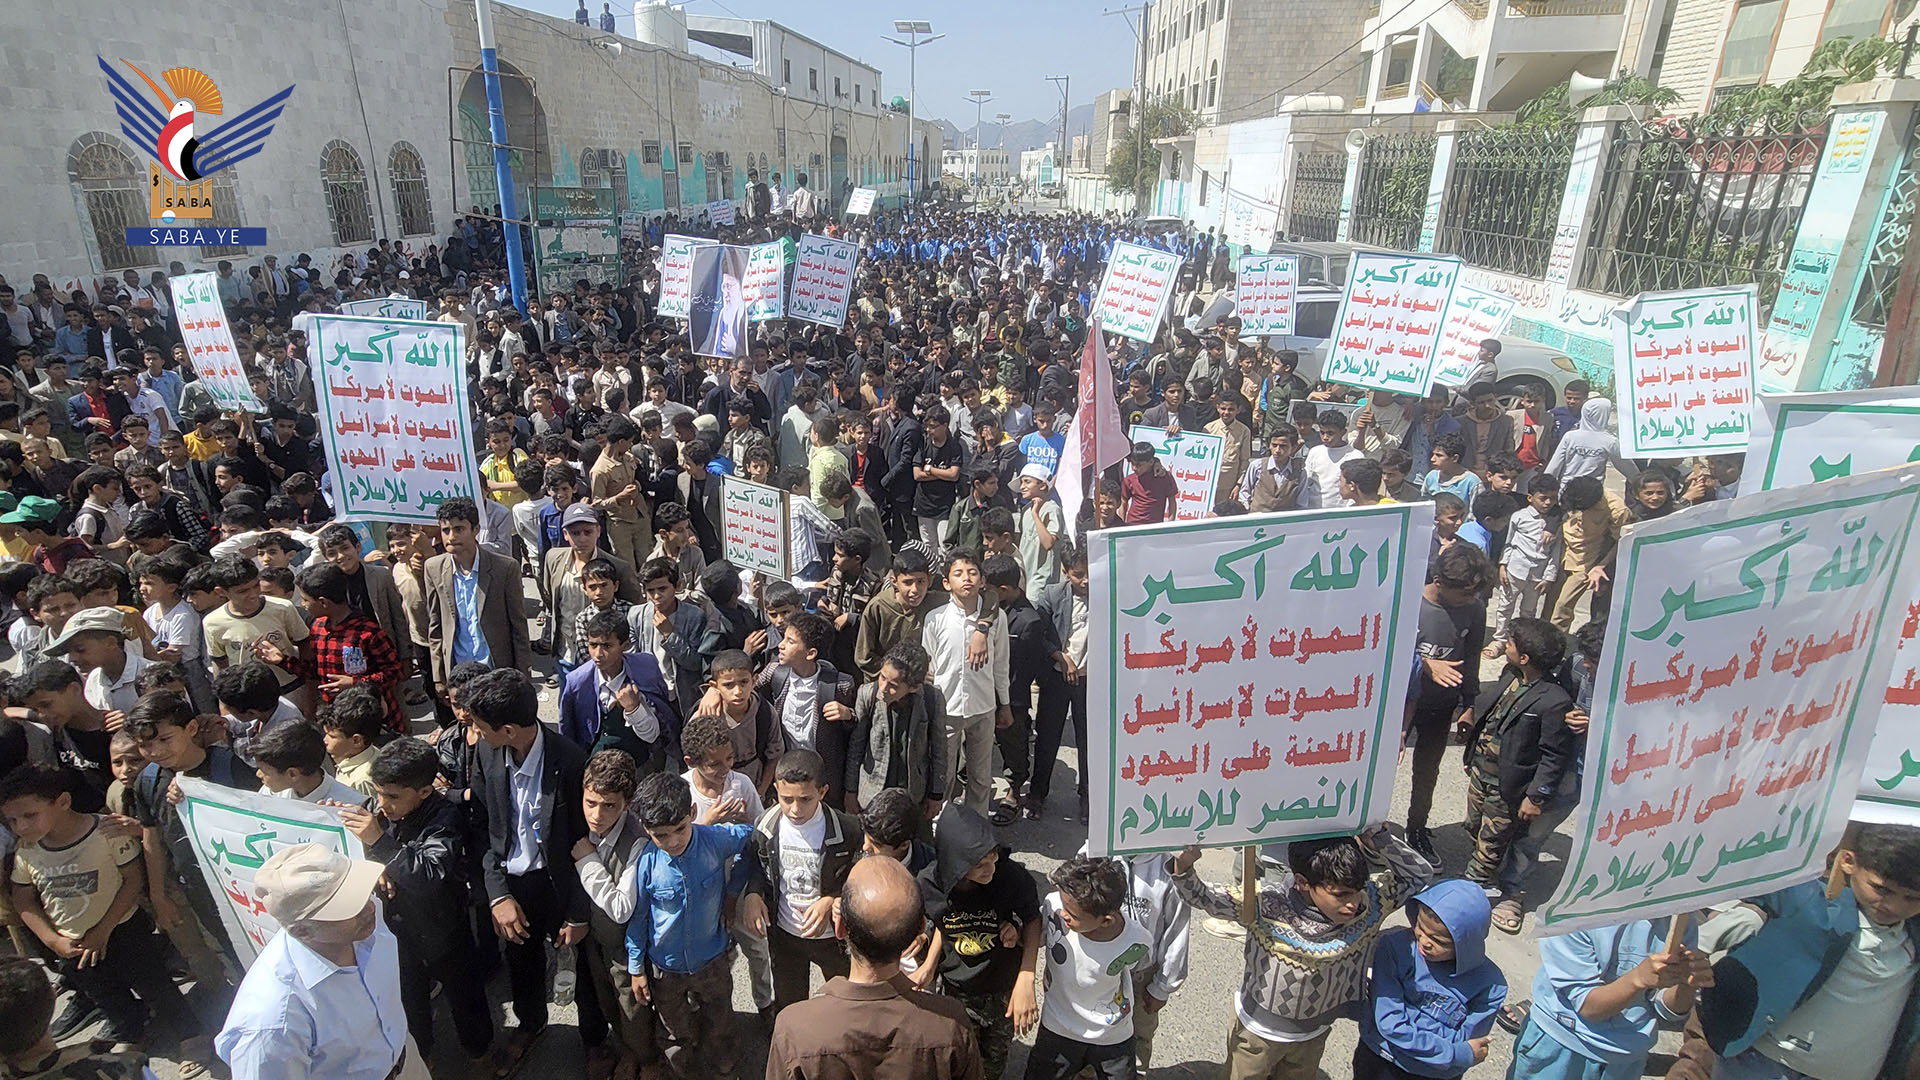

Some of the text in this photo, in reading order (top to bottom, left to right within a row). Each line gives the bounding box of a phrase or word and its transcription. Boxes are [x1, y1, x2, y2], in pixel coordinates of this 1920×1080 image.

[1355, 258, 1452, 288] الله أكبر
[1352, 288, 1444, 313] الموت لأمريكا
[1455, 294, 1485, 311] أك
[1632, 300, 1745, 338] الله أكبر
[1103, 310, 1126, 329] للإسلا
[1243, 318, 1264, 333] للإسلا
[1345, 311, 1437, 337] الموت لإسرائيل
[326, 325, 450, 372] الله أكبر
[1338, 334, 1430, 360] اللعنة على اليهود
[1634, 335, 1746, 360] الموت لأمريكا
[1332, 355, 1425, 385] النصر للإسلام
[1637, 362, 1747, 387] الموت لإسرائيل
[330, 372, 454, 407] الموت لأمريكا
[1637, 388, 1749, 413] اللعنة على اليهود
[335, 410, 457, 442] الموت لإسرائيل
[1640, 410, 1751, 444] النصر للإسلام
[341, 446, 462, 472] اللعنة على اليهود
[349, 475, 407, 511] للإسلام
[1808, 516, 1899, 592] الله
[1120, 527, 1390, 625] الله أكبر
[1630, 520, 1809, 647] أكبر
[1123, 612, 1382, 676] الموت لأمريكا
[1770, 607, 1873, 677] الموت
[1624, 625, 1767, 706] لأمريكا
[1122, 672, 1374, 735] الموت لإسرائيل
[1752, 677, 1853, 745] الموت
[1121, 728, 1367, 786] اللعنة على اليهود
[1610, 705, 1749, 785] لإسرائيل
[1119, 776, 1359, 844] النصر للإسلام
[1596, 784, 1692, 847] اليهود
[1694, 773, 1746, 824] على
[1572, 801, 1815, 903] النصر للإسلام
